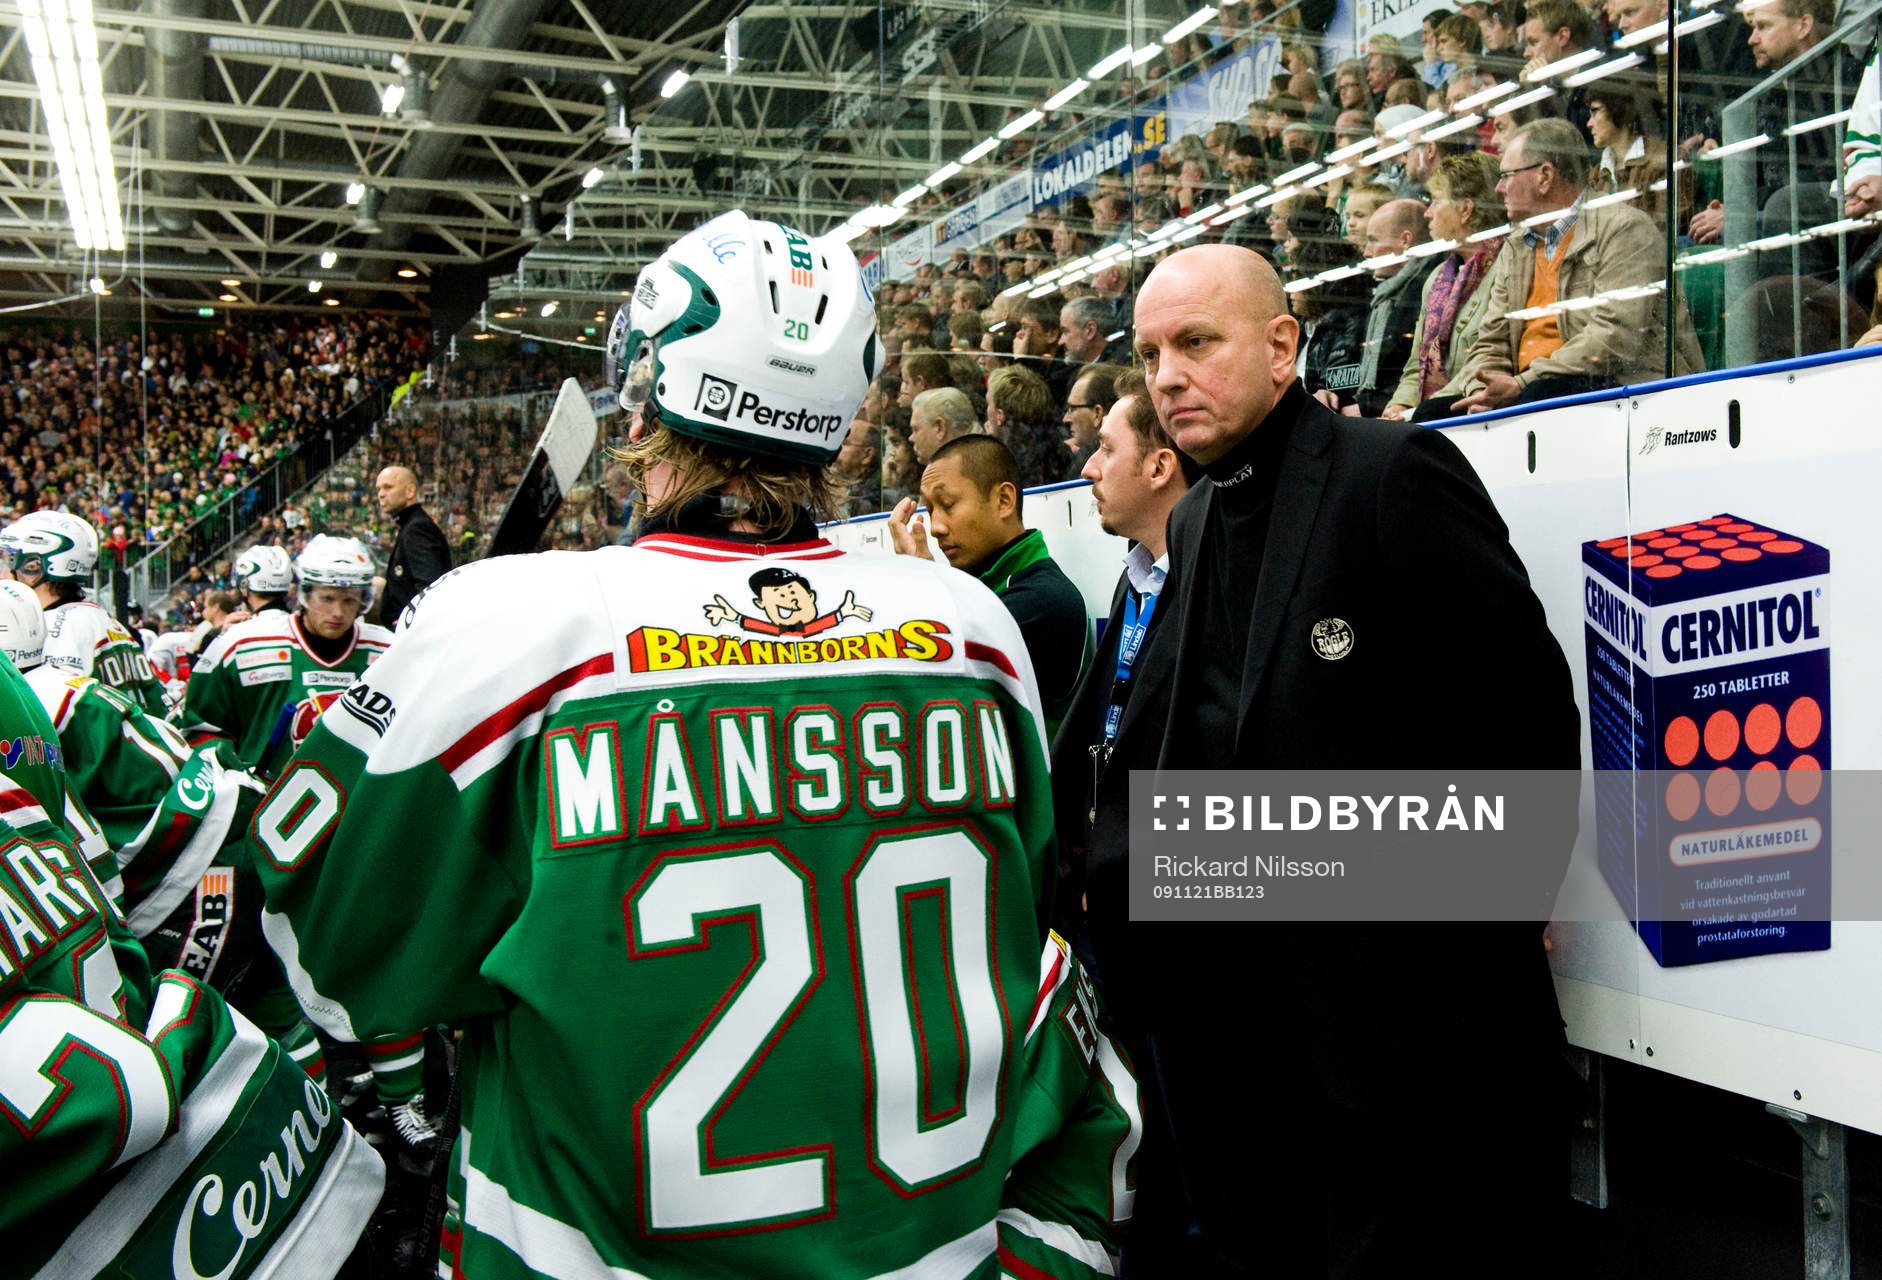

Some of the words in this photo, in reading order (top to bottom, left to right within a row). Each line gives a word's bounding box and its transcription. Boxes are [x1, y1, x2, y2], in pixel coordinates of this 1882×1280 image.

[1033, 129, 1132, 205] LOKALDELEN
[779, 223, 813, 271] AB
[783, 318, 810, 341] 20
[736, 391, 842, 441] Perstorp
[1664, 428, 1718, 447] Rantzows
[1585, 576, 1647, 662] CERNITOL
[1661, 589, 1820, 665] CERNITOL
[628, 620, 957, 674] BRÄNNBORNS
[1693, 682, 1717, 700] 250
[1719, 670, 1791, 695] TABLETTER
[545, 698, 1016, 850] MÅNSSON
[1681, 828, 1808, 856] NATURLÄKEMEDEL
[1680, 899, 1696, 910] vid
[1695, 874, 1754, 891] Traditionellt
[1692, 912, 1735, 927] orsakade
[1737, 913, 1749, 922] av
[1751, 904, 1797, 923] godartad
[622, 818, 1013, 1240] 20
